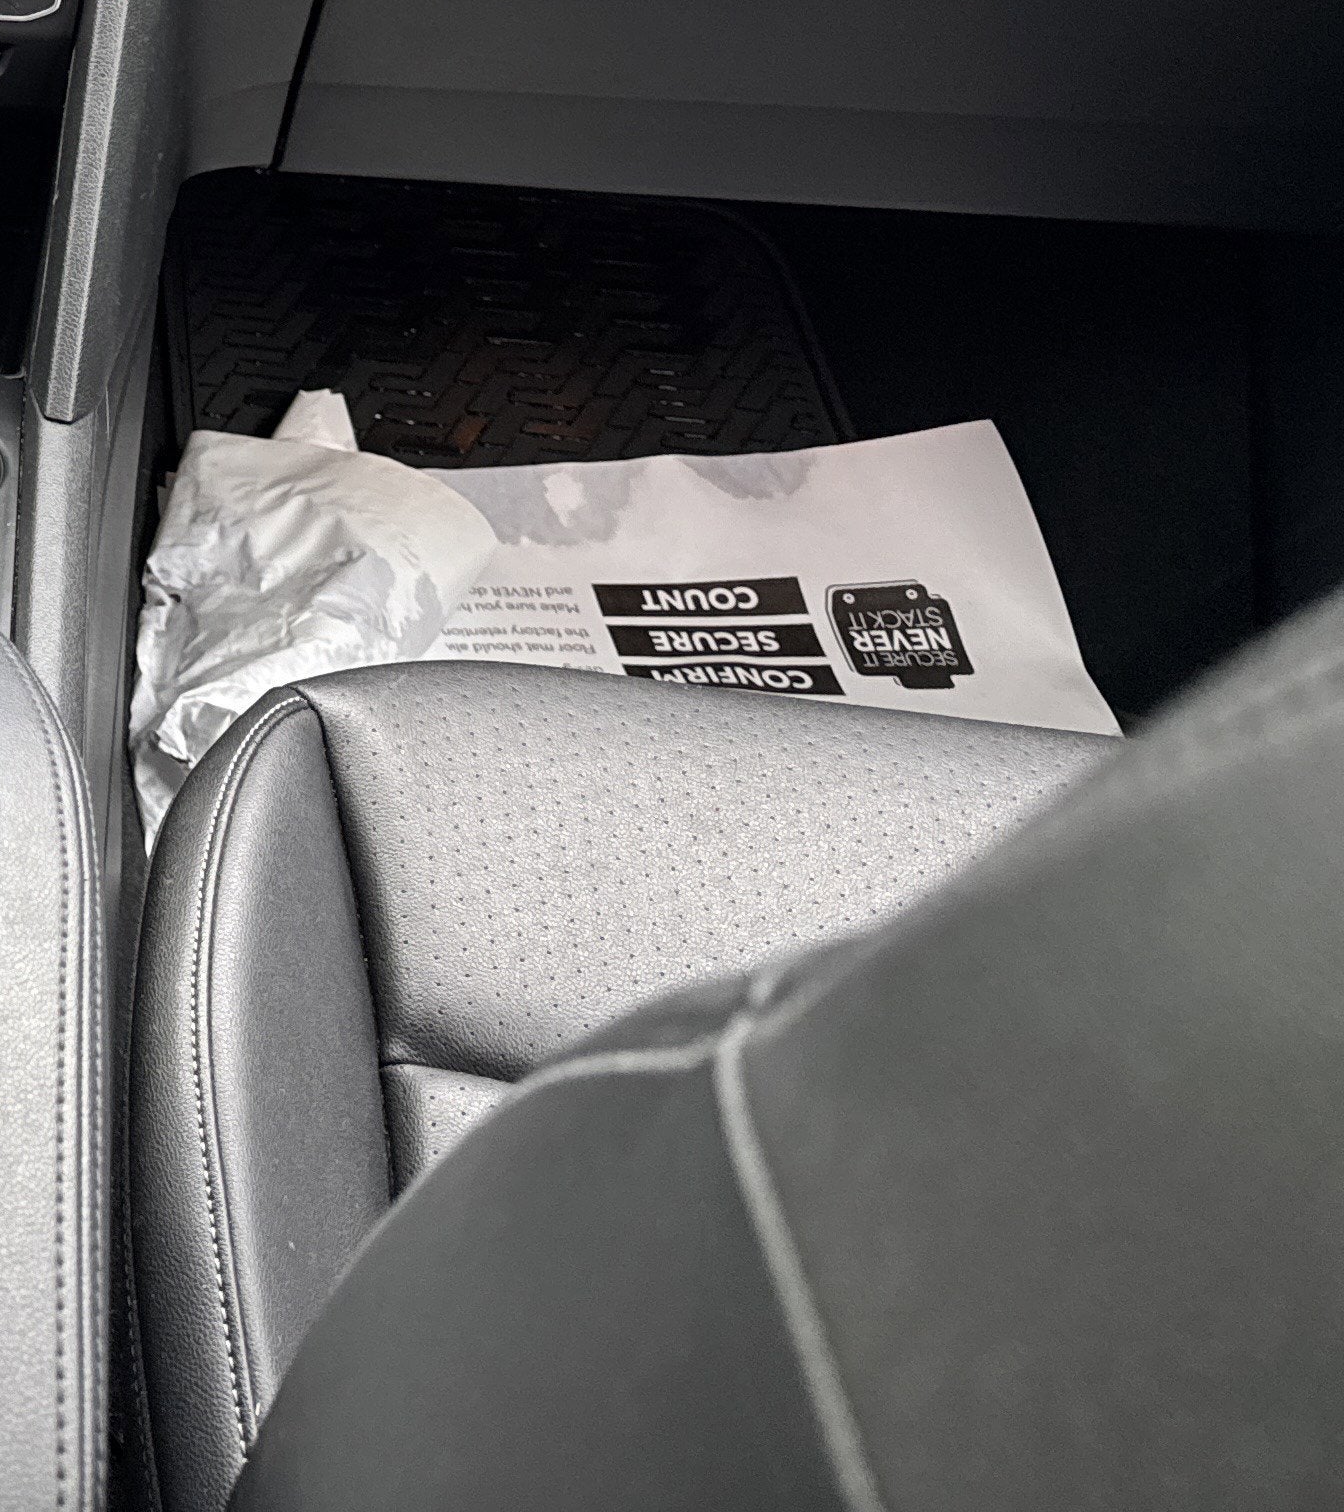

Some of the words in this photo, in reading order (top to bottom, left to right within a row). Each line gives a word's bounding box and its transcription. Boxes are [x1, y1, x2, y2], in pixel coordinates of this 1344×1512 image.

[492, 585, 543, 598] NEVER
[545, 586, 574, 597] and
[641, 585, 760, 612] COUNT
[474, 600, 503, 611] you
[506, 602, 537, 611] sure
[540, 602, 580, 614] Make
[848, 611, 867, 630] IT
[867, 606, 944, 629] STACK
[441, 626, 508, 638] retention
[511, 624, 562, 638] factory
[564, 627, 591, 638] the
[648, 629, 781, 653] SECURE
[849, 626, 953, 652] NEVER
[472, 642, 524, 654] should
[527, 642, 554, 652] mat
[559, 642, 597, 655] Floor
[862, 650, 880, 668] IT
[880, 649, 959, 667] SECURE
